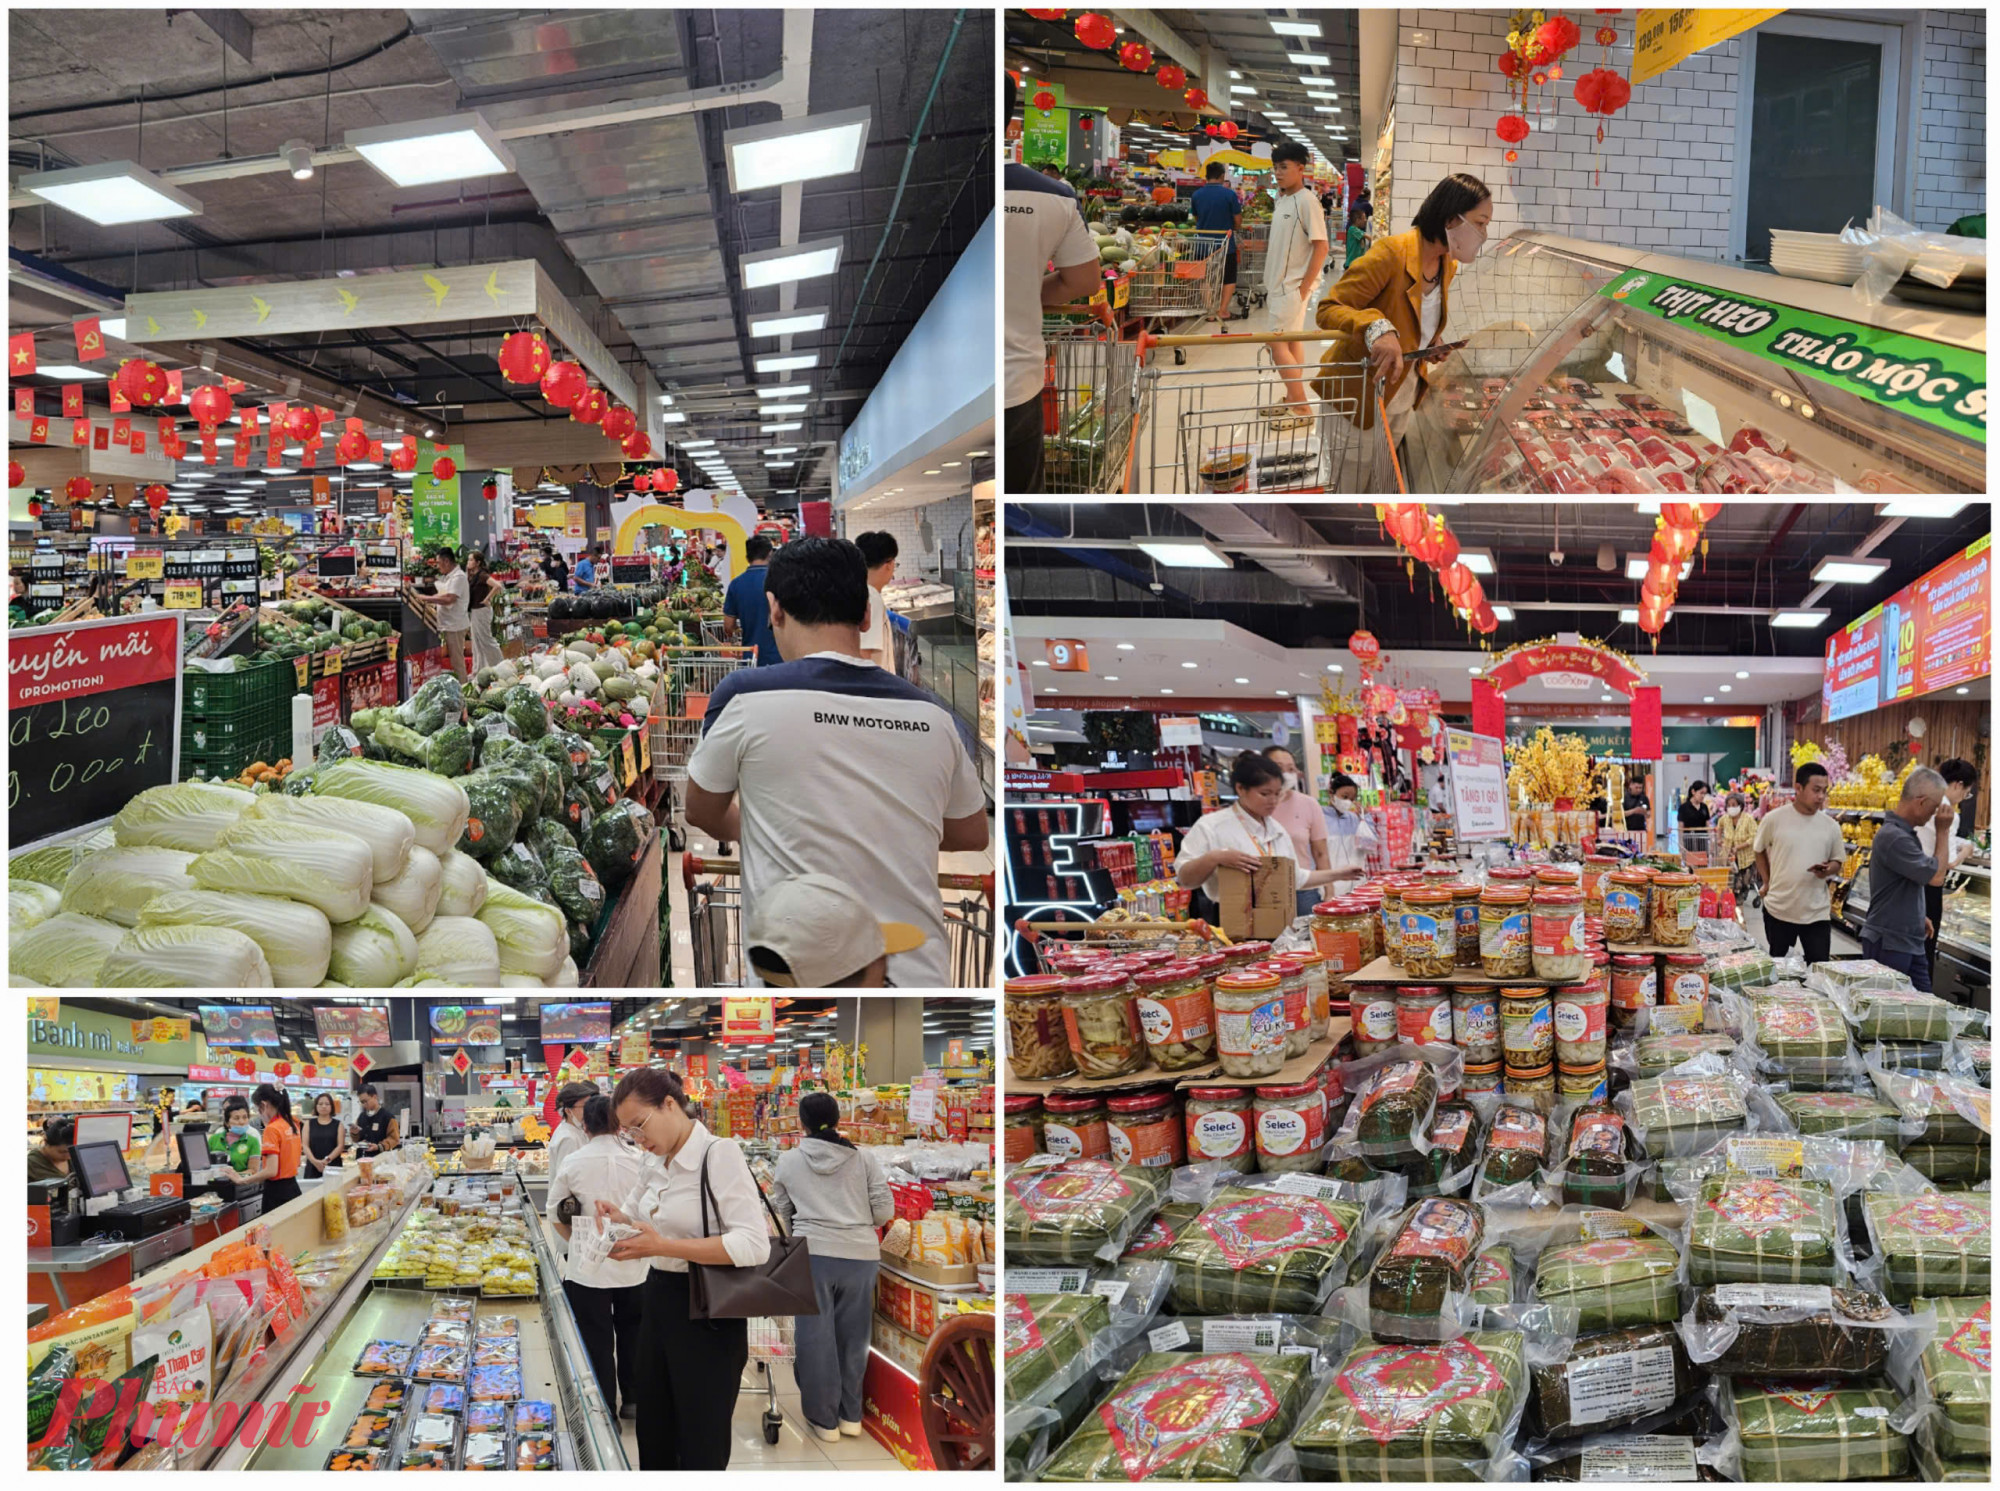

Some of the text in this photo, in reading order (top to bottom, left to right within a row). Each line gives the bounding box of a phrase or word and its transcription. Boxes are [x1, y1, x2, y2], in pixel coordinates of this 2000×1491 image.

[1654, 285, 1773, 334] THỊT HEO
[1774, 331, 1986, 421] THẢO MỘC S
[316, 492, 327, 502] 18
[381, 502, 390, 511] 17
[100, 631, 153, 661] mãi
[1900, 621, 1914, 653] 10
[1054, 645, 1069, 664] 9
[19, 675, 104, 699] (PROMOTION)
[814, 712, 930, 732] BMW MOTORRAD
[1461, 786, 1480, 807] TẶNG
[1681, 981, 1701, 989] Select
[1558, 1011, 1580, 1021] Select
[89, 1028, 112, 1052] mì
[1203, 1122, 1237, 1132] Select
[1265, 1120, 1297, 1129] Select
